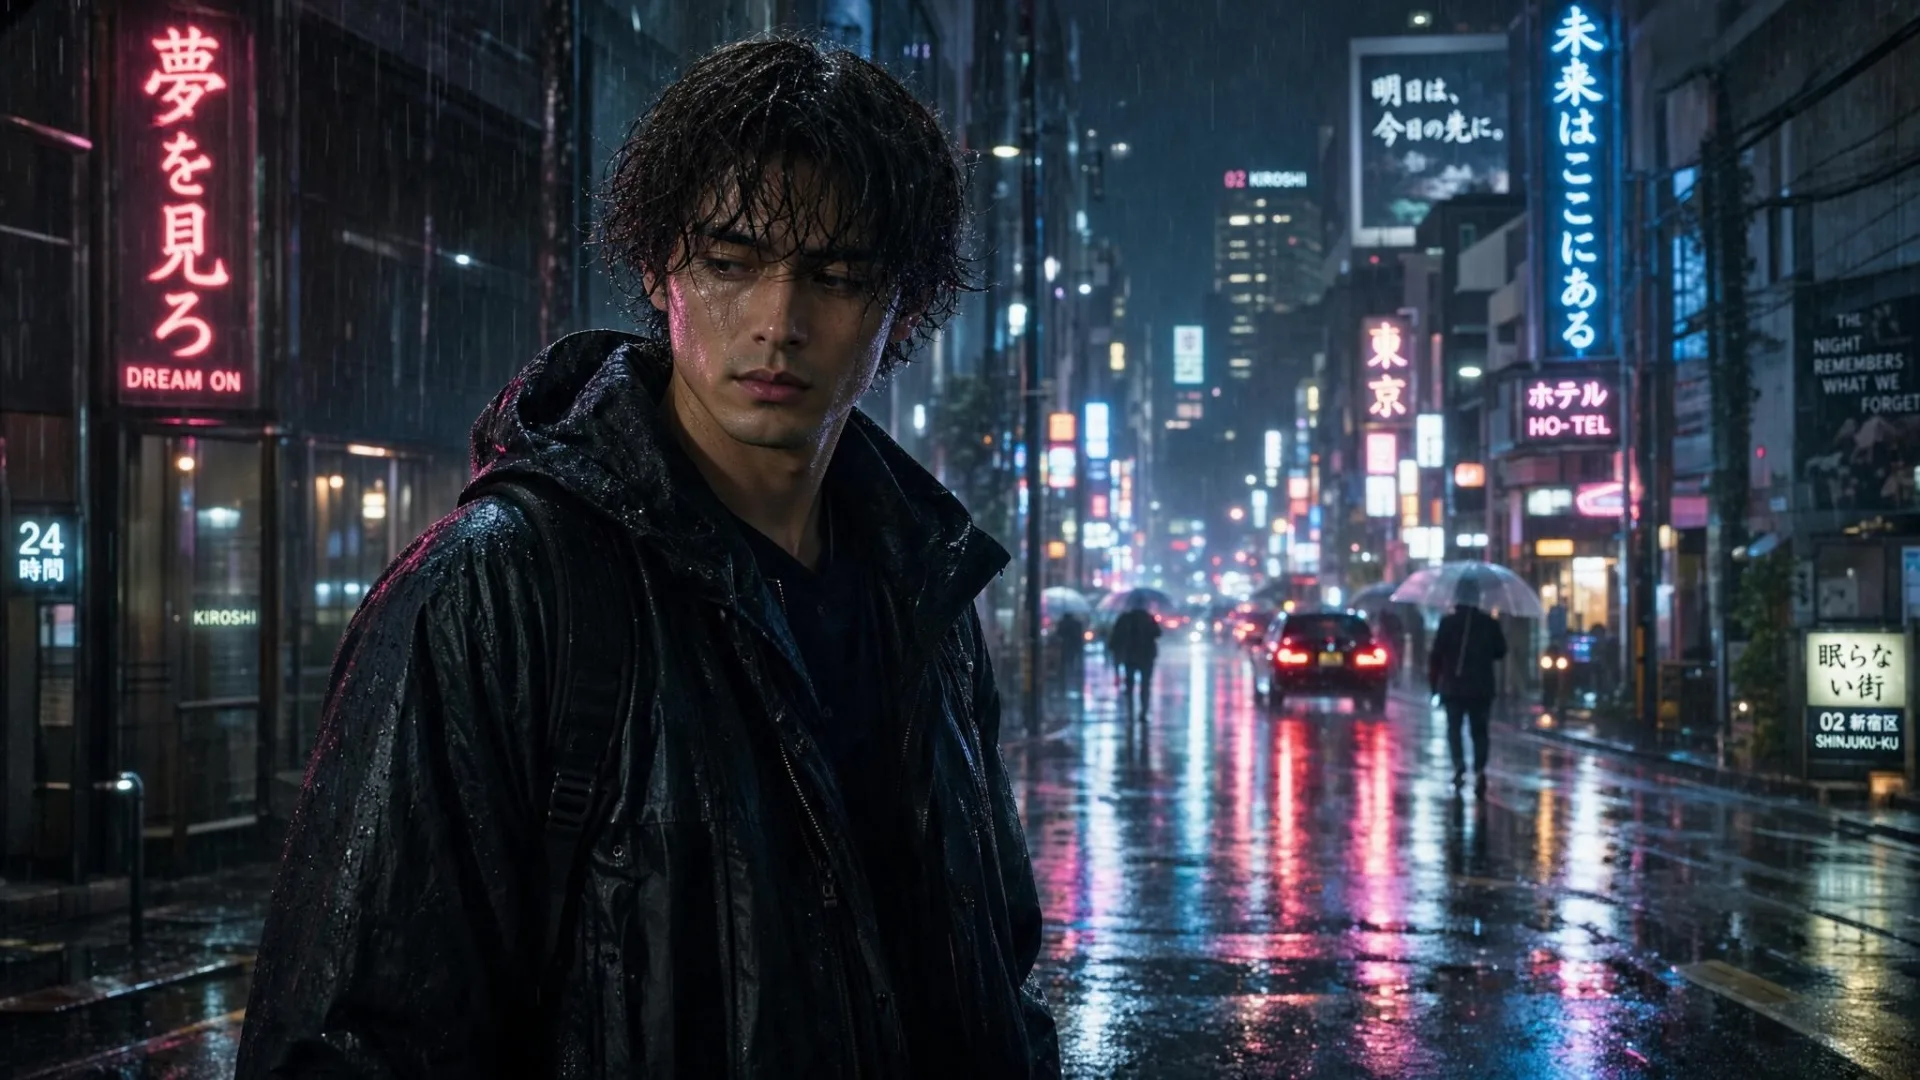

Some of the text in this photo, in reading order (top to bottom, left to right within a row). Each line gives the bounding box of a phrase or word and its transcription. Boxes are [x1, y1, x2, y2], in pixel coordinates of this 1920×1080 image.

[1371, 73, 1459, 107] 明日は、
[1371, 109, 1504, 147] 今日の先に。
[1551, 5, 1604, 348] 未来はここにある
[144, 26, 230, 357] 夢を見ろ
[1836, 313, 1862, 328] THE
[1813, 335, 1862, 354] NIGHT
[1367, 321, 1407, 418] 東京
[1813, 352, 1904, 375] REMEMBERS
[126, 367, 241, 392] DREAM ON
[1822, 373, 1901, 395] WHAT WE
[1528, 381, 1608, 410] ホテル
[1861, 393, 1920, 414] FORGET
[1529, 415, 1611, 436] HO-TEL
[19, 521, 65, 556] 24
[19, 557, 65, 582] 時間
[194, 609, 257, 626] KIROSHI
[1818, 643, 1892, 669] 眠らな
[1831, 673, 1884, 701] い街
[1820, 712, 1899, 732] 02 新宿区
[1815, 734, 1899, 750] SHINJUKU-KU
